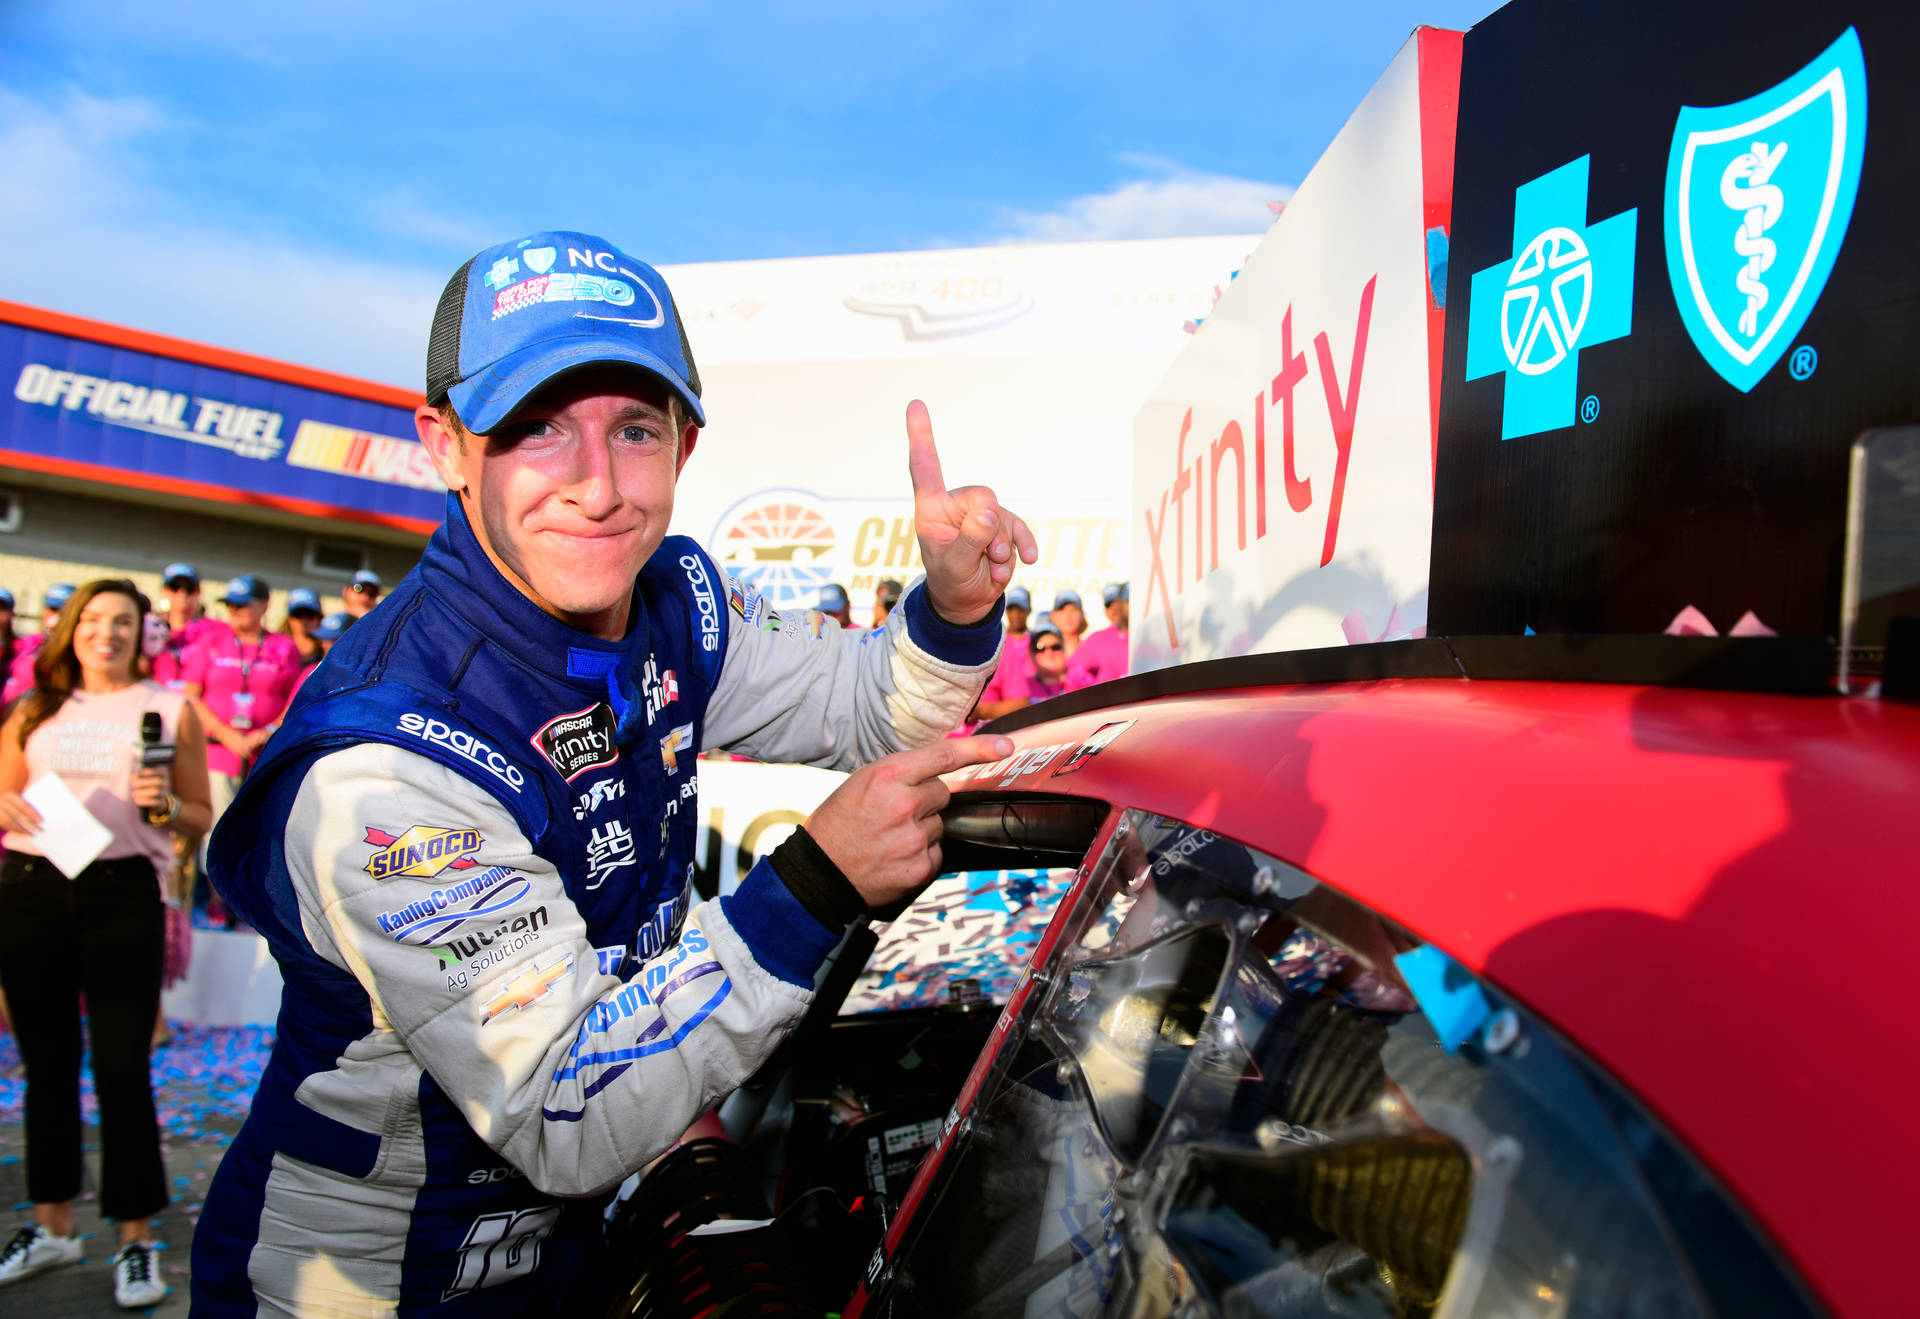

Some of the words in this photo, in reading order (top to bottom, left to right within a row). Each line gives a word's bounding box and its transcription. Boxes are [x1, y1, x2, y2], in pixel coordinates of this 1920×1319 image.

[567, 247, 618, 272] NC
[544, 272, 636, 307] 250
[14, 363, 189, 432] OFFICIAL
[195, 397, 283, 448] FUEL
[361, 437, 440, 488] NAS
[1144, 272, 1377, 649] xfinity
[852, 516, 1126, 570] CHTTE
[678, 553, 720, 652] sparco
[550, 726, 609, 770] xfinity
[554, 716, 593, 736] NASCAR
[397, 713, 525, 793] sparco
[570, 752, 599, 770] SERIES
[373, 829, 477, 876] SUNOCO
[447, 972, 468, 992] Ag
[470, 931, 540, 977] Solutions
